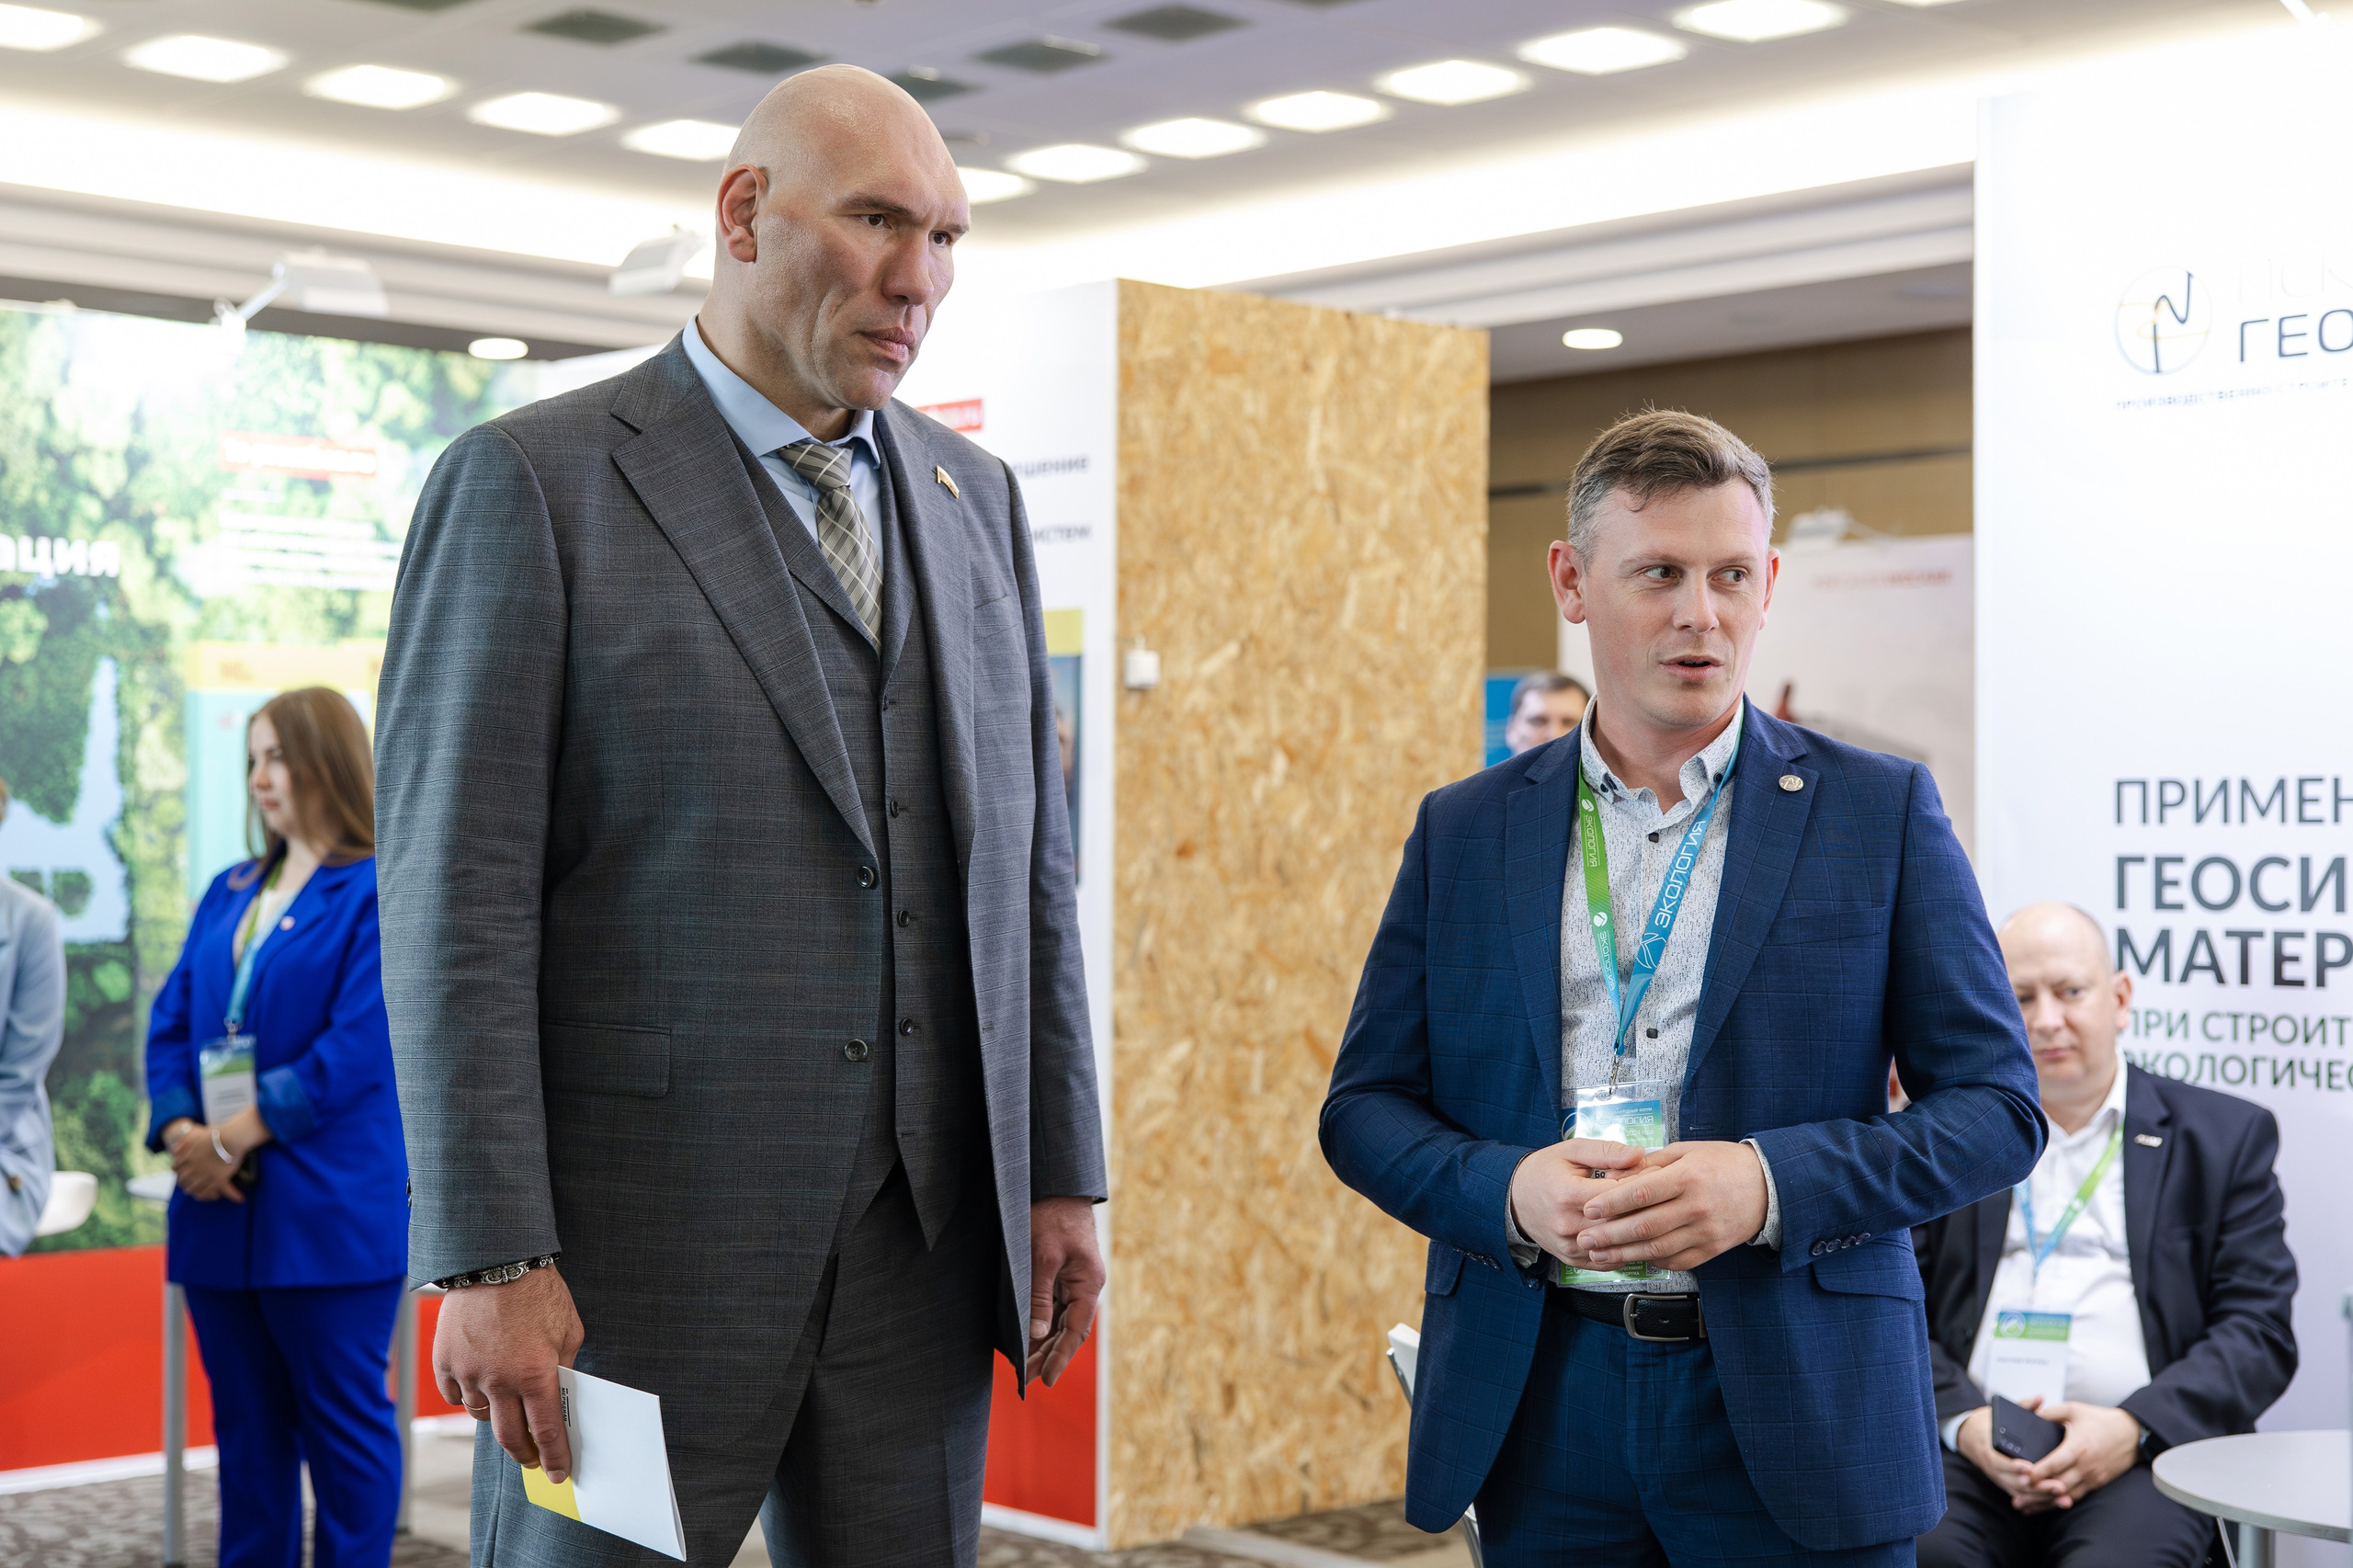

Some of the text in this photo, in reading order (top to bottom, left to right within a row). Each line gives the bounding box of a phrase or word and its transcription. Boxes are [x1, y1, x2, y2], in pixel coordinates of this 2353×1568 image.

[2239, 308, 2353, 363] ГЕО
[2115, 777, 2353, 824] ПРИМЕН
[1585, 814, 1597, 868] ЭКОЛОГИЯ
[1654, 820, 1706, 929] ЭКОЛОГИЯ
[2116, 856, 2347, 913] ГЕОСИ
[1599, 930, 1615, 991] ЭКОЛОГИЯ
[2116, 928, 2353, 988] МАТЕР
[2201, 1012, 2352, 1046] СТРОИТ
[2125, 1051, 2353, 1091] КОЛОГИЧЕ
[1595, 1170, 1606, 1178] Бо
